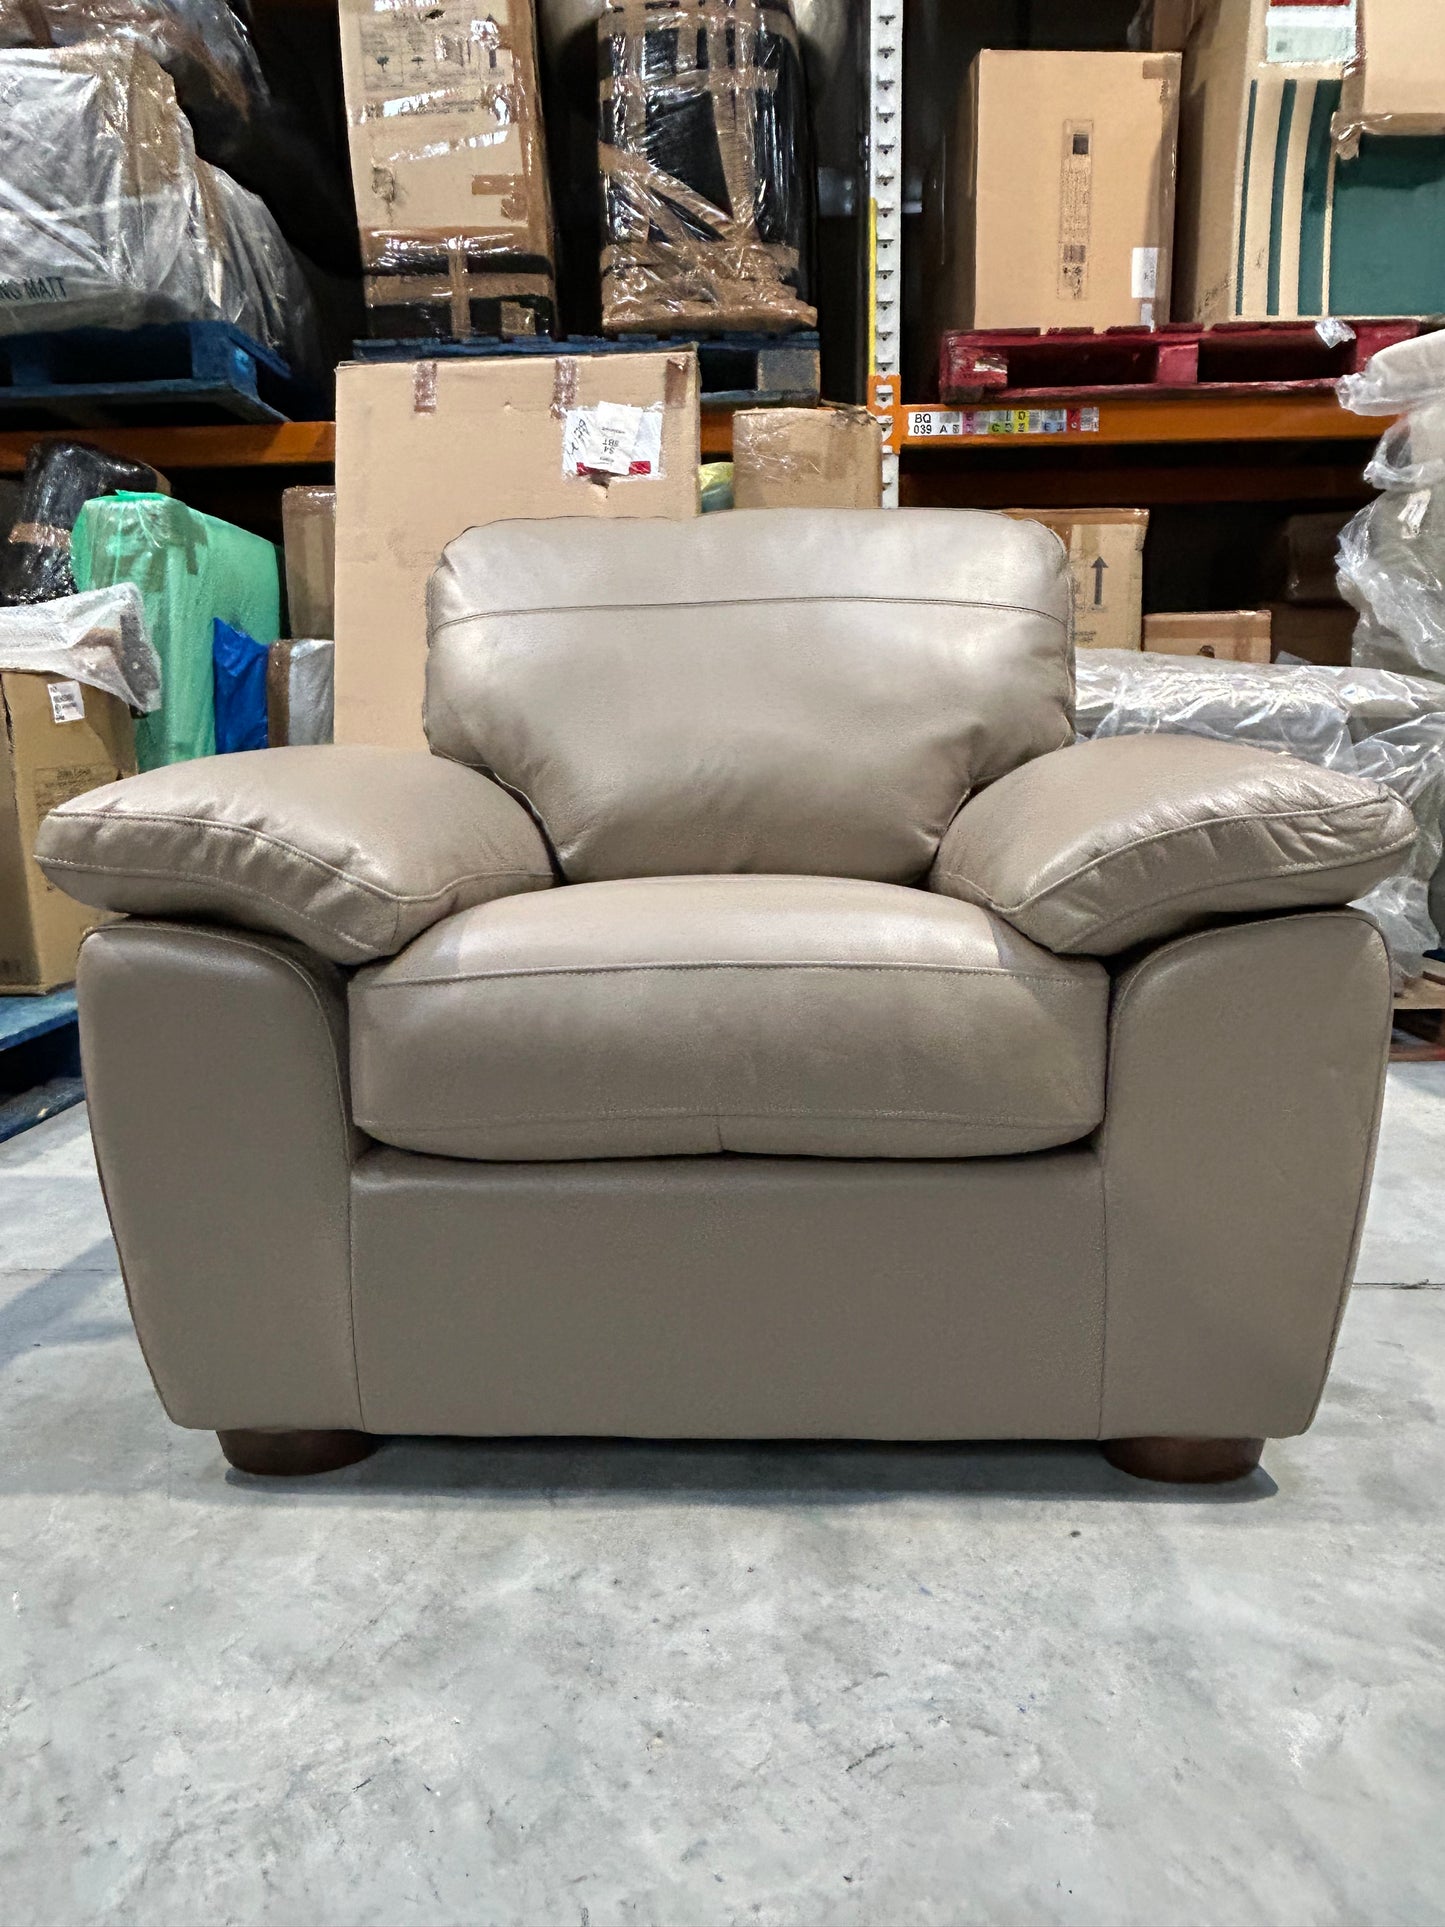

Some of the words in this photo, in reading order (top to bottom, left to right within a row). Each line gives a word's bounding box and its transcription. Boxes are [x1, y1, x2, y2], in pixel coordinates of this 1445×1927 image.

[914, 413, 932, 424] BQ
[913, 424, 932, 435] 039
[939, 424, 948, 434] A
[991, 423, 1000, 432] C
